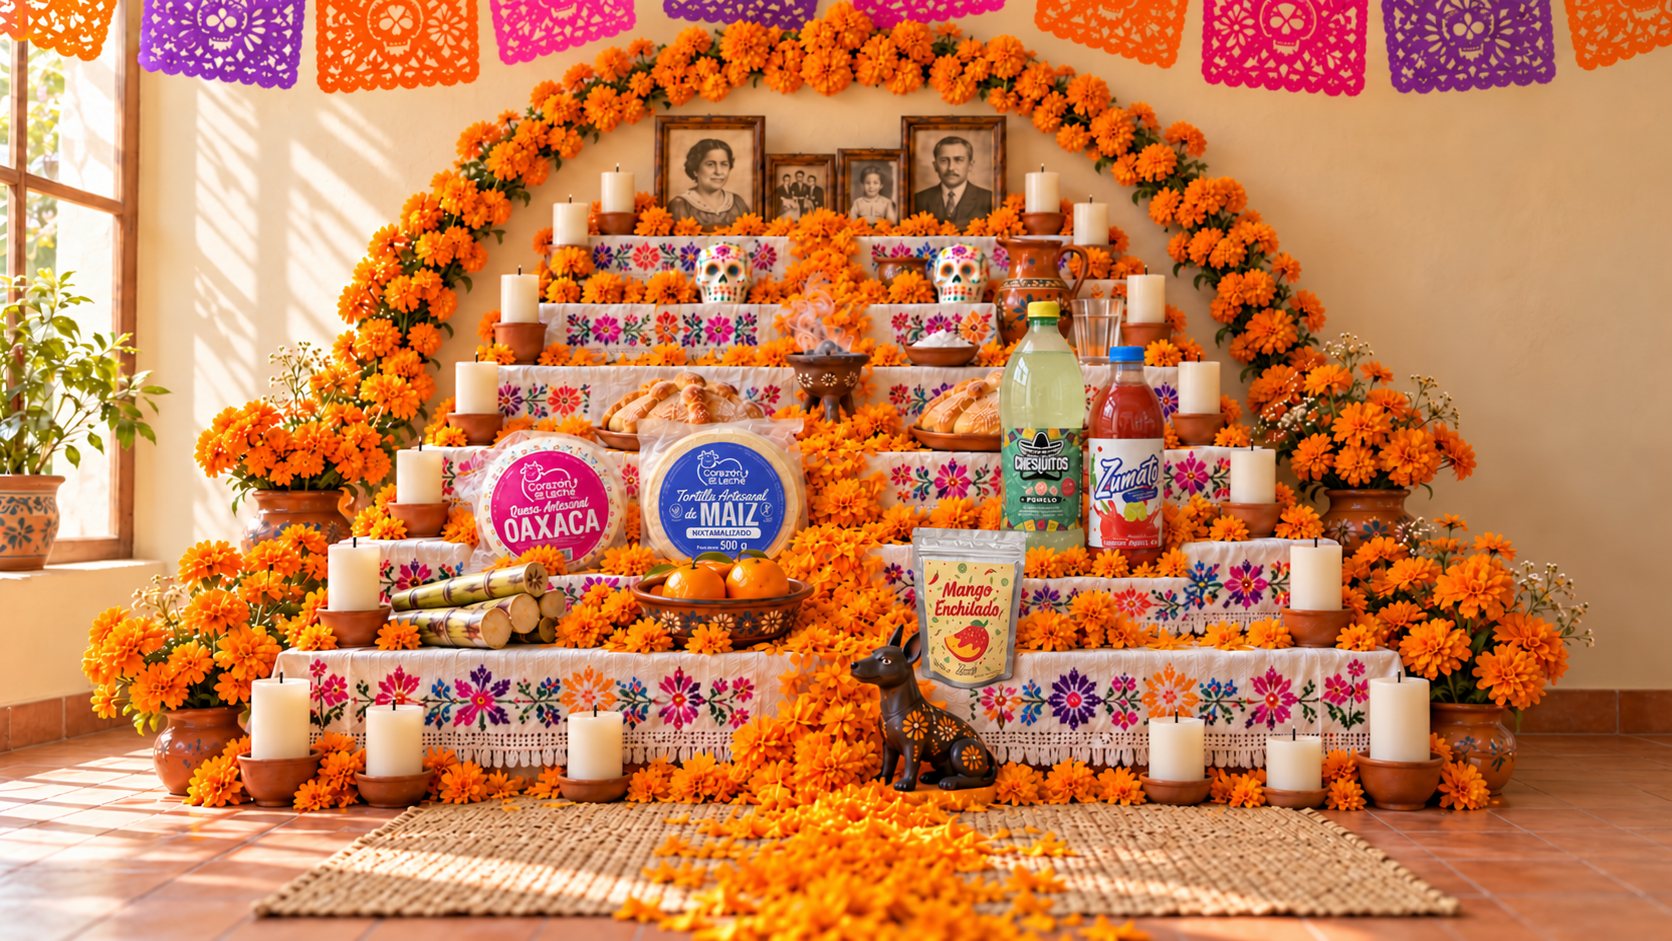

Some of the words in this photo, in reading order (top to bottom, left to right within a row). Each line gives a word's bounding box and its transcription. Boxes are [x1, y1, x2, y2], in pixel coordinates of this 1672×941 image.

[527, 477, 578, 492] Corazón
[1094, 454, 1159, 500] Zumato
[676, 488, 716, 502] Tortilla
[718, 488, 769, 501] Artesanal
[543, 496, 589, 513] Artesanal
[684, 507, 698, 519] de
[700, 501, 759, 527] MAIZ
[504, 509, 601, 543] OAXACA
[692, 529, 752, 537] NIXTAMALIZADO
[720, 540, 738, 550] 500
[740, 542, 748, 552] g
[942, 581, 993, 601] Mango
[934, 599, 1000, 617] Enchilado
